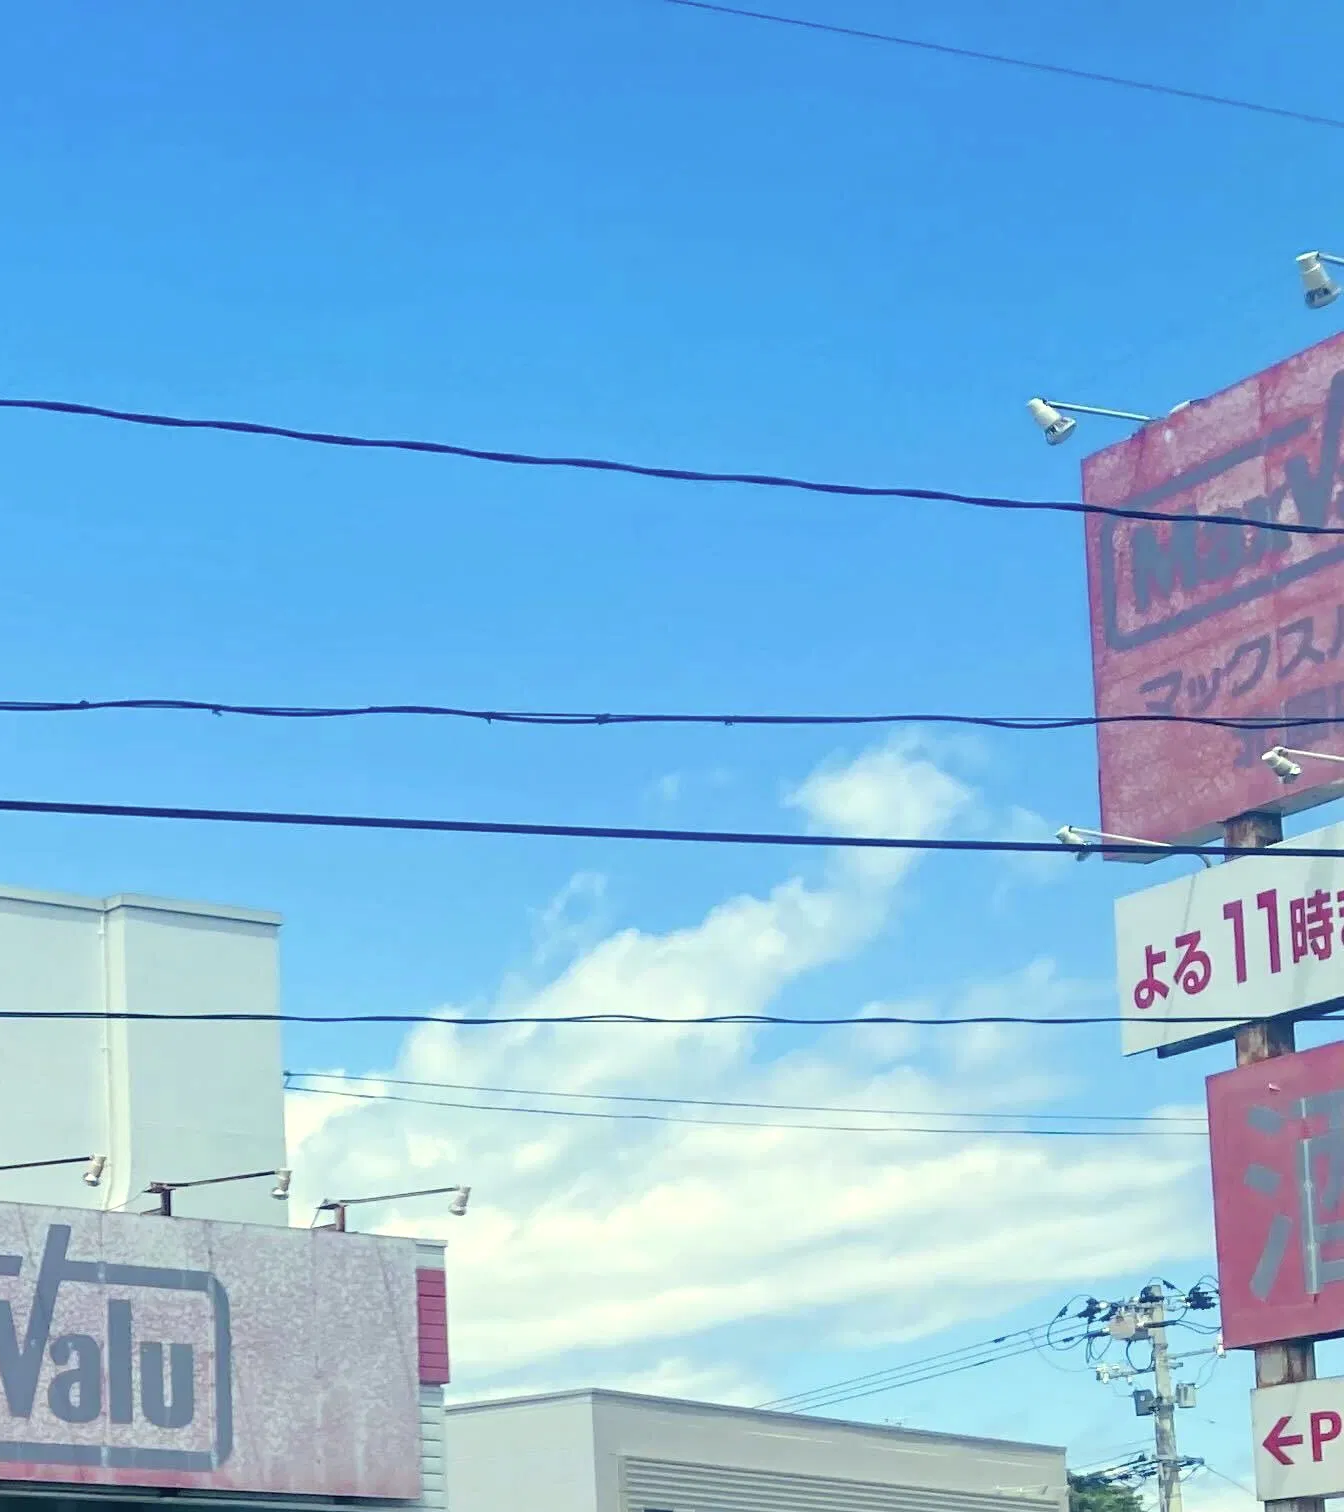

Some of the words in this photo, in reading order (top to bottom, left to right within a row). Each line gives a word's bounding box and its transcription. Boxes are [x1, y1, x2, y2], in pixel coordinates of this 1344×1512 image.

[1131, 368, 1344, 614] MaxV
[1138, 604, 1344, 717] マックス
[1310, 1411, 1342, 1462] P
